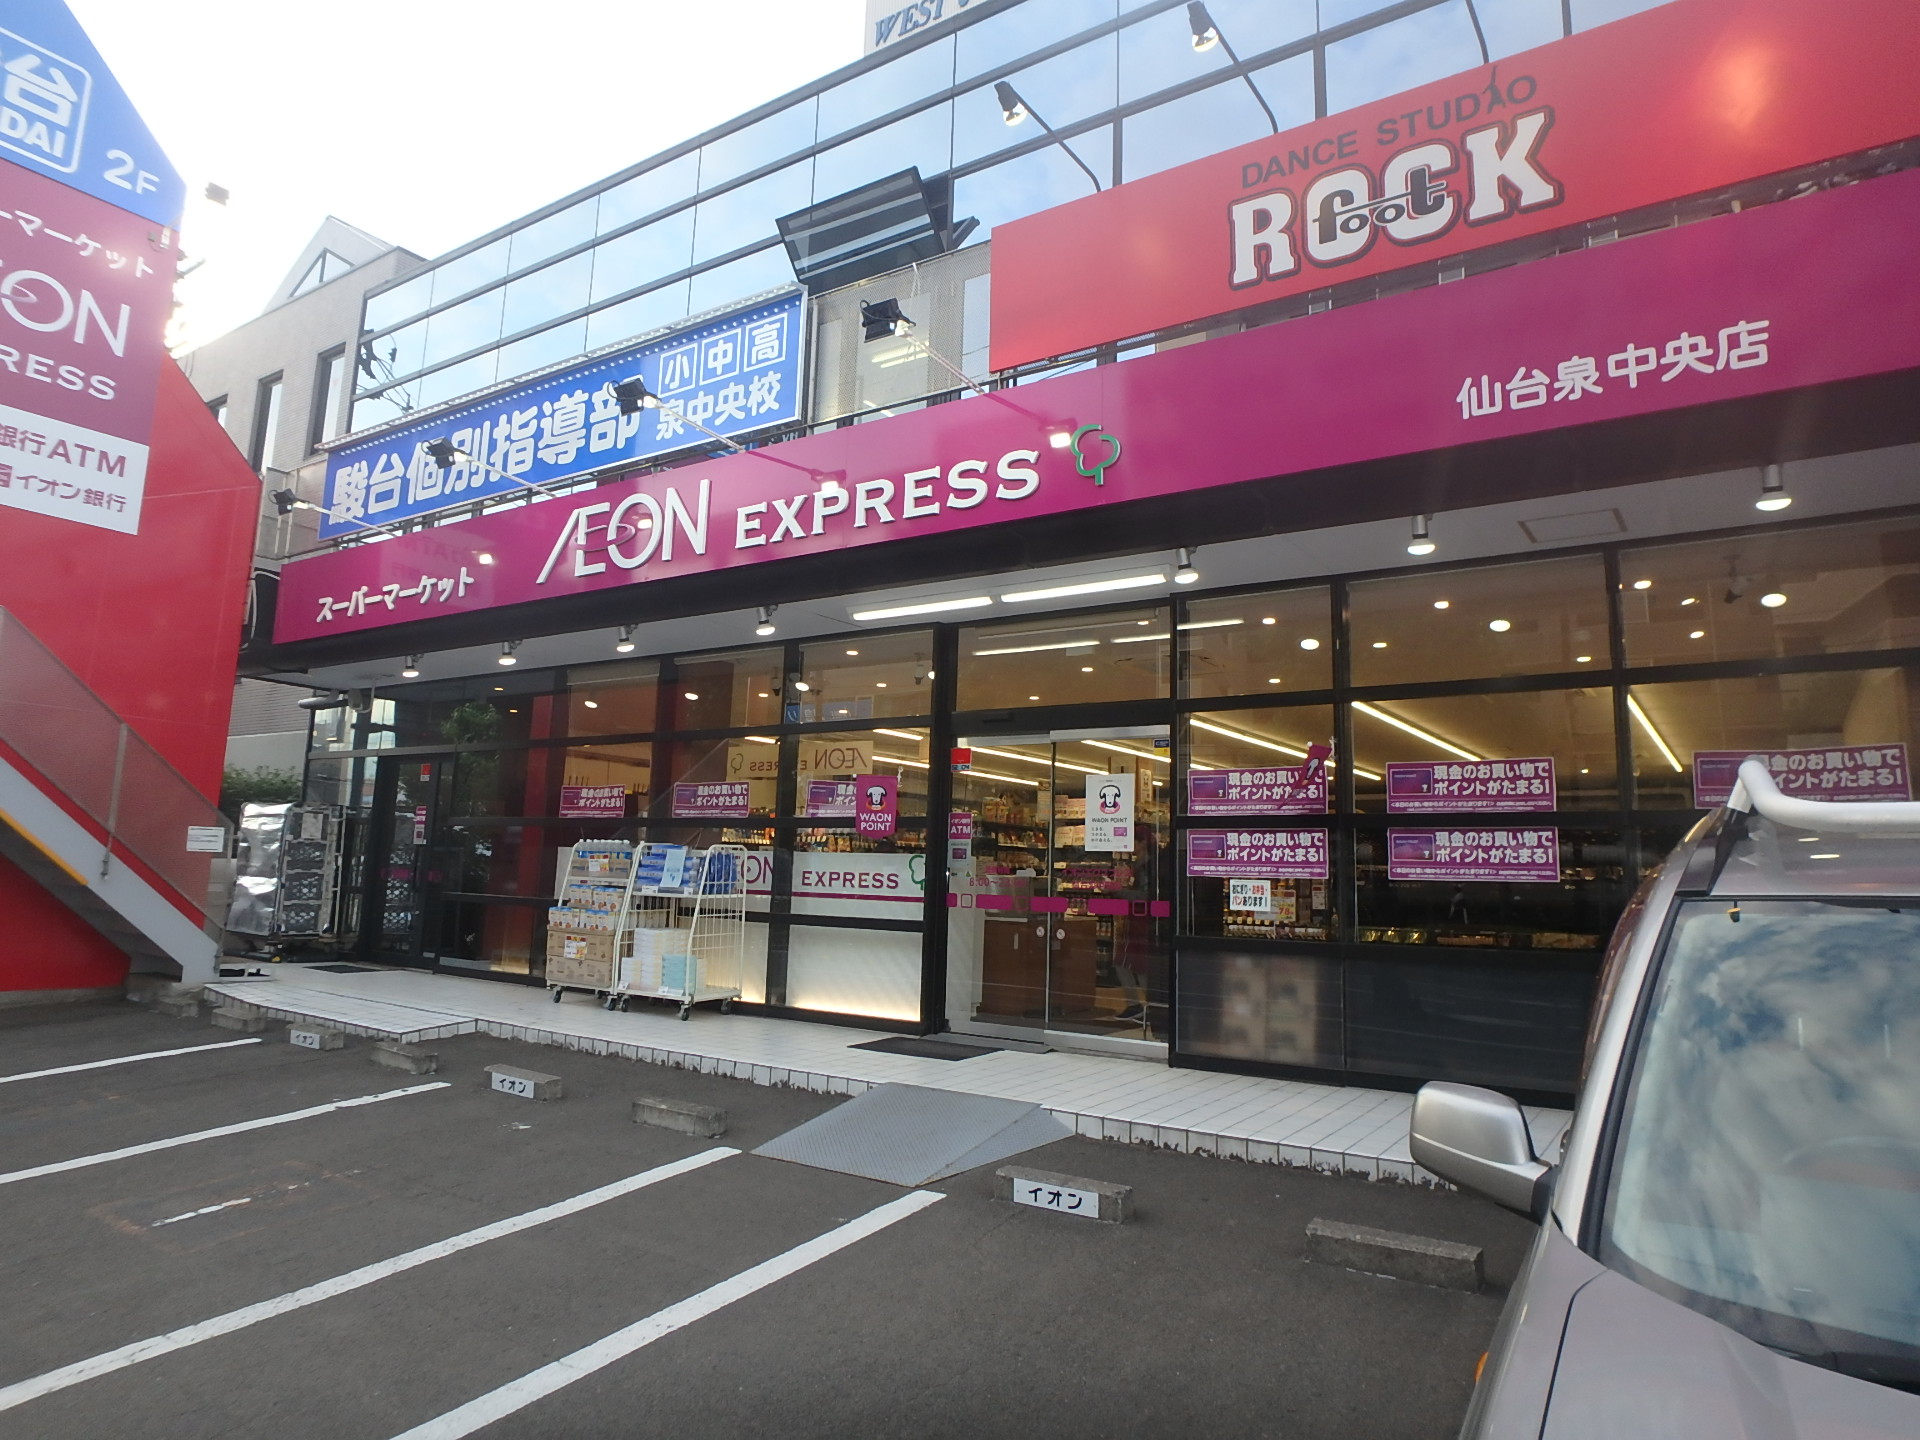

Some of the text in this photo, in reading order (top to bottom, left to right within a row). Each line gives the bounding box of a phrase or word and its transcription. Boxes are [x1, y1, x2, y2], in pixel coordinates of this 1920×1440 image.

[875, 0, 944, 47] WEST
[0, 53, 79, 128] 台
[103, 148, 161, 195] 2F
[1241, 130, 1359, 189] DANCE
[1229, 106, 1565, 290] ROCK
[0, 258, 131, 358] ON
[1456, 320, 1770, 420] 仙台泉中央店
[656, 370, 782, 441] 泉中央校
[328, 374, 645, 527] 駿台個別指導部
[734, 449, 1041, 550] EXPRESS
[316, 566, 475, 623] スーパーマーケット
[1433, 762, 1550, 780] 現金のお買い物で
[860, 812, 892, 822] WAON
[860, 822, 892, 831] POINT
[950, 825, 971, 835] ATM
[1226, 832, 1324, 846] 現金のお買い物で
[1435, 831, 1553, 847] 現金のお買い物で
[801, 870, 900, 890] EXPRESS
[295, 1033, 315, 1046] イオン
[499, 1078, 527, 1094] イオン
[1028, 1187, 1083, 1210] イオン
